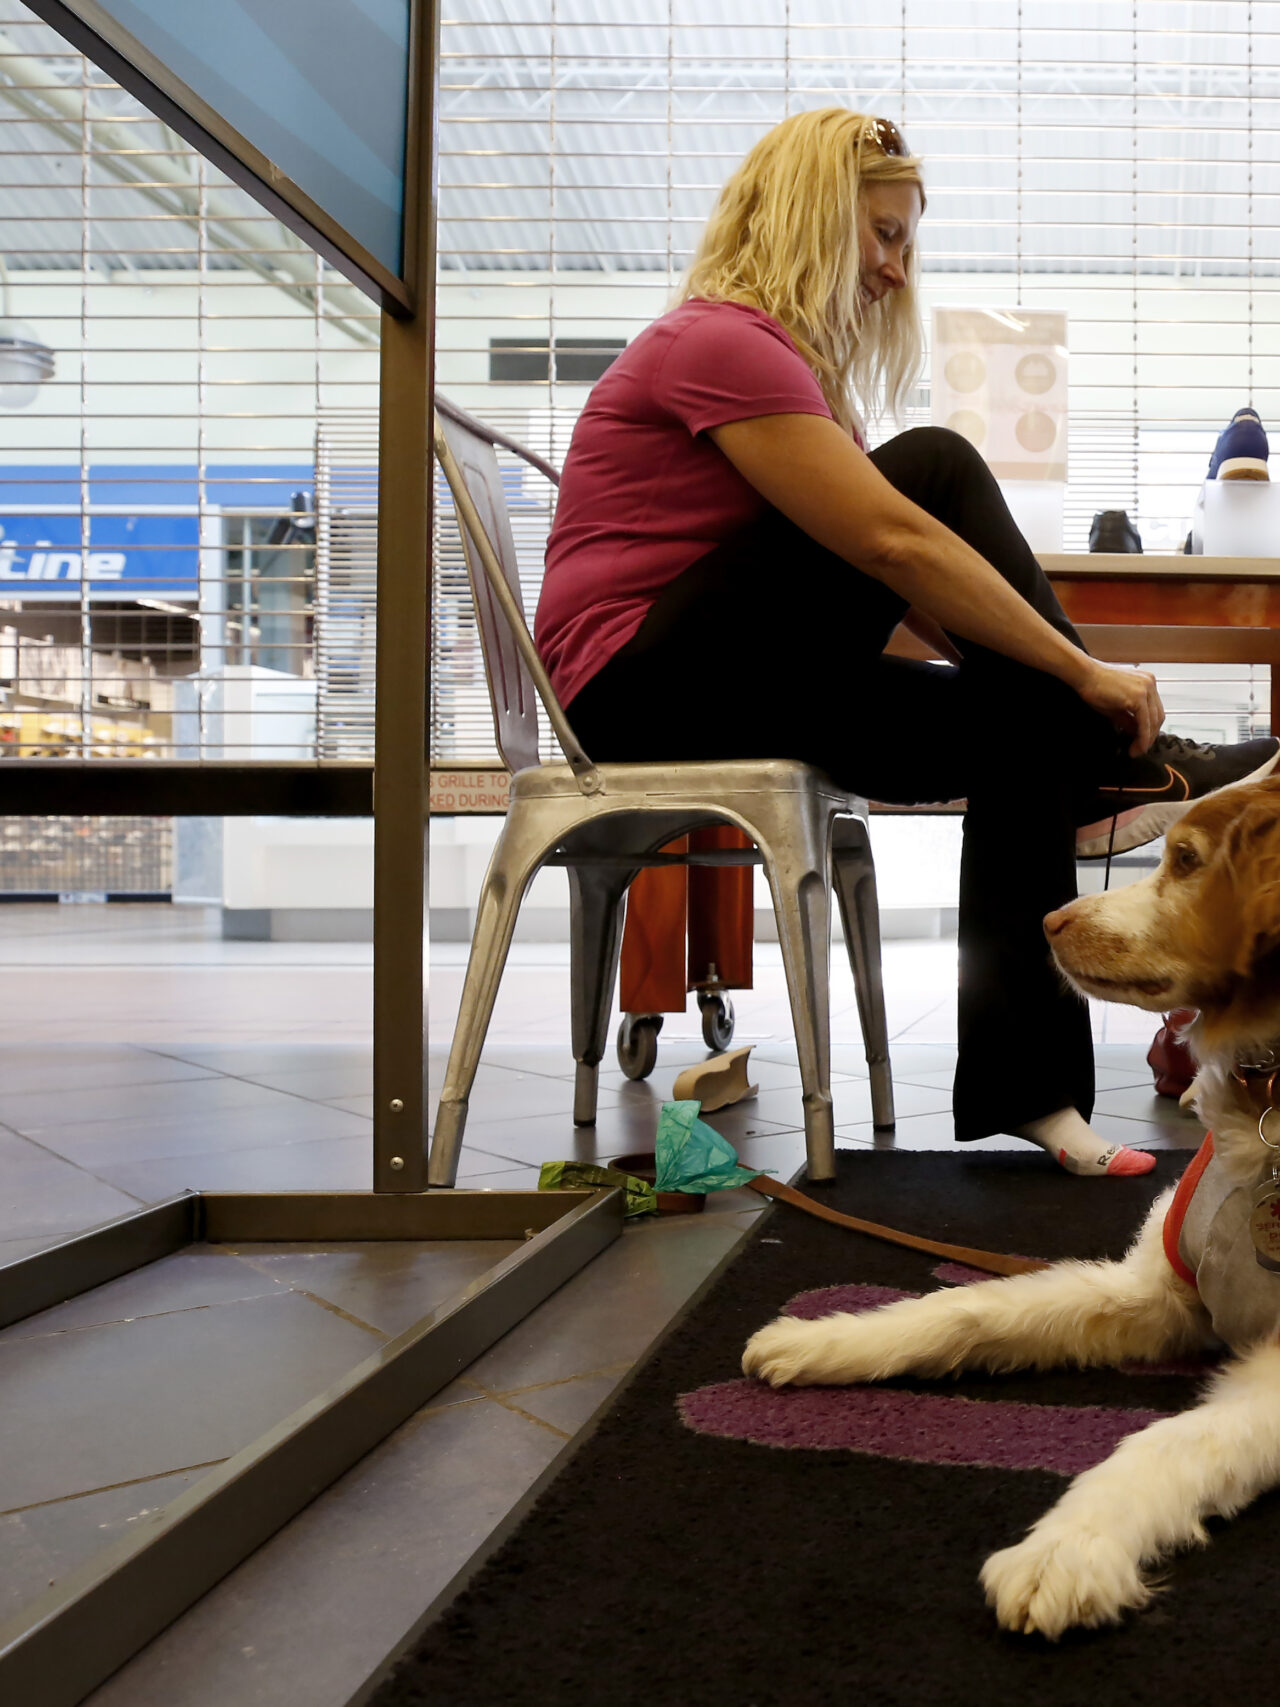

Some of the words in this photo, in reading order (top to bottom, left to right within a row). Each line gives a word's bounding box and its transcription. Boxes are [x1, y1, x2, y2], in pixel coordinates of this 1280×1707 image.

[438, 775, 484, 788] GRILLE
[490, 775, 508, 788] TO
[430, 794, 455, 807] KED
